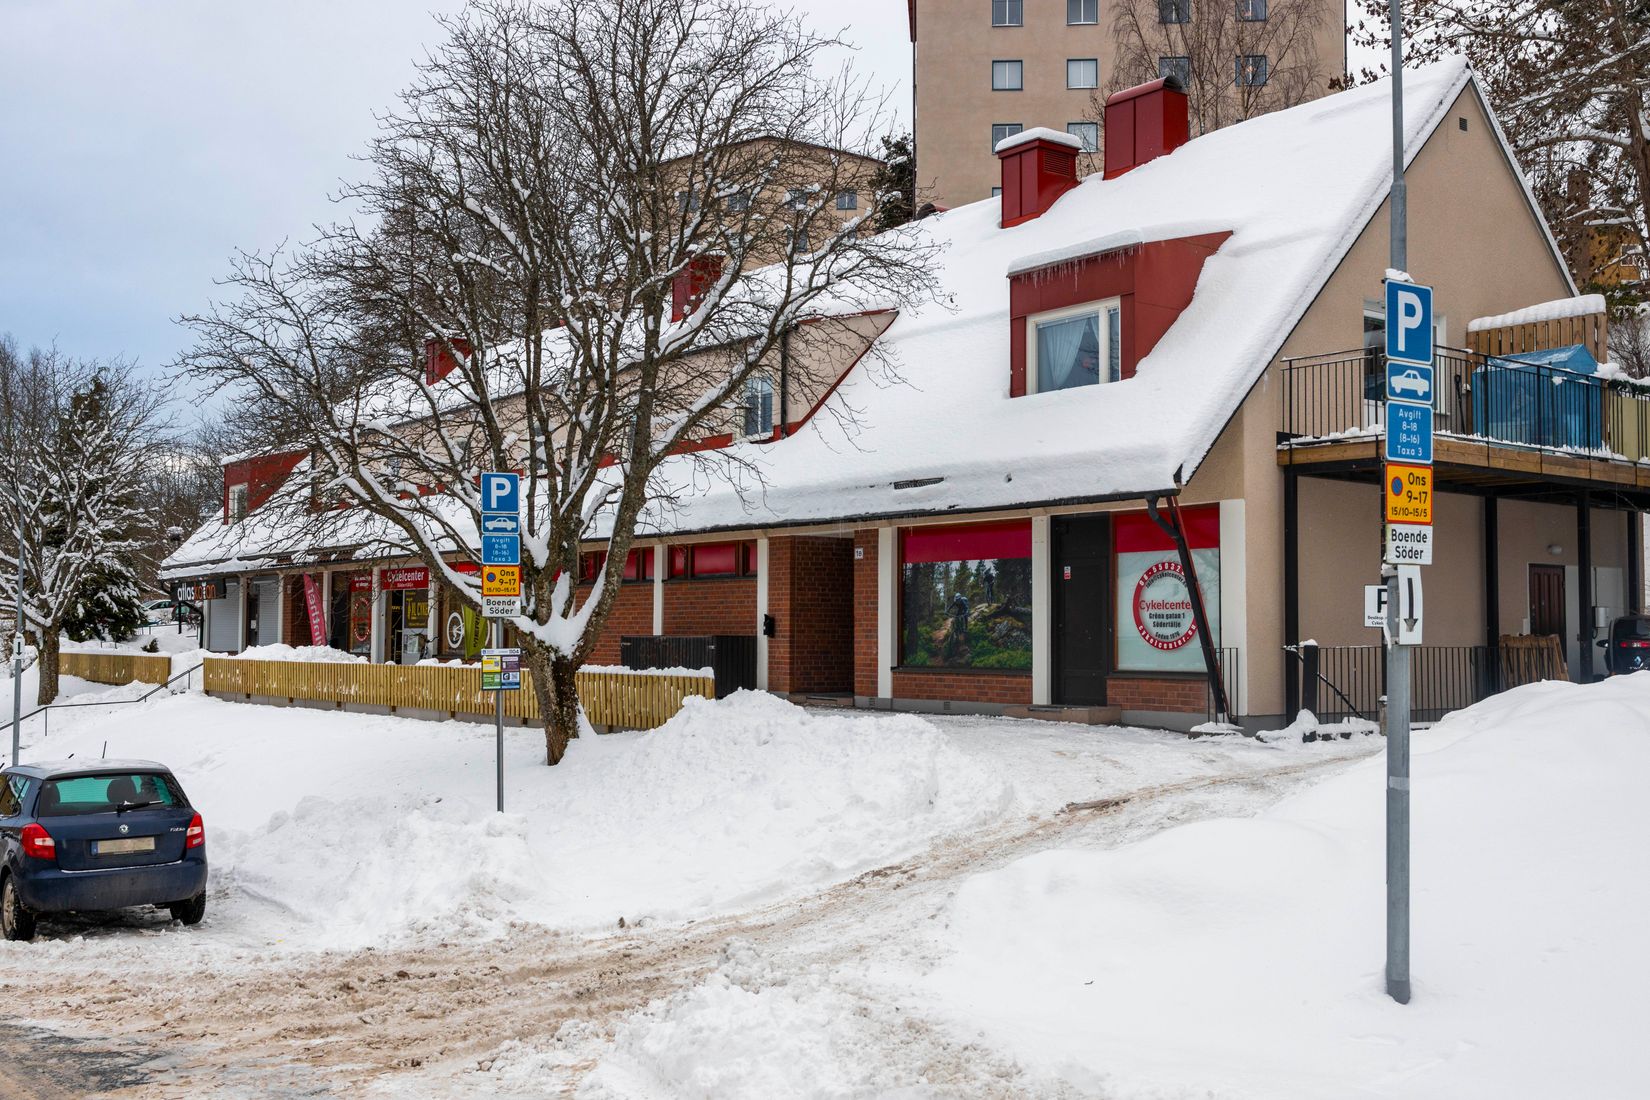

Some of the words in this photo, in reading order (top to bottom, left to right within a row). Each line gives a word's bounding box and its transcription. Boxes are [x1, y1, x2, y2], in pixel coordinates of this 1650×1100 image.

[1397, 290, 1424, 352] P
[1398, 408, 1422, 420] Avgift
[1401, 422, 1418, 432] 8-18
[1399, 433, 1420, 445] (8-16)
[1397, 445, 1416, 456] Taxa
[1417, 446, 1423, 457] 3
[1408, 472, 1427, 486] Ons
[490, 477, 512, 509] P
[1406, 490, 1428, 505] 9-17
[1391, 506, 1428, 518] 15/10-15/5
[1391, 528, 1428, 544] Boende
[1394, 545, 1424, 560] Söder
[386, 569, 424, 584] Cykelcenter
[499, 569, 515, 577] Ons
[1139, 562, 1185, 587] 08-55032
[498, 578, 516, 586] 9-17
[486, 598, 517, 606] Boende
[489, 606, 514, 615] Söder
[1152, 620, 1181, 628] Södertälje
